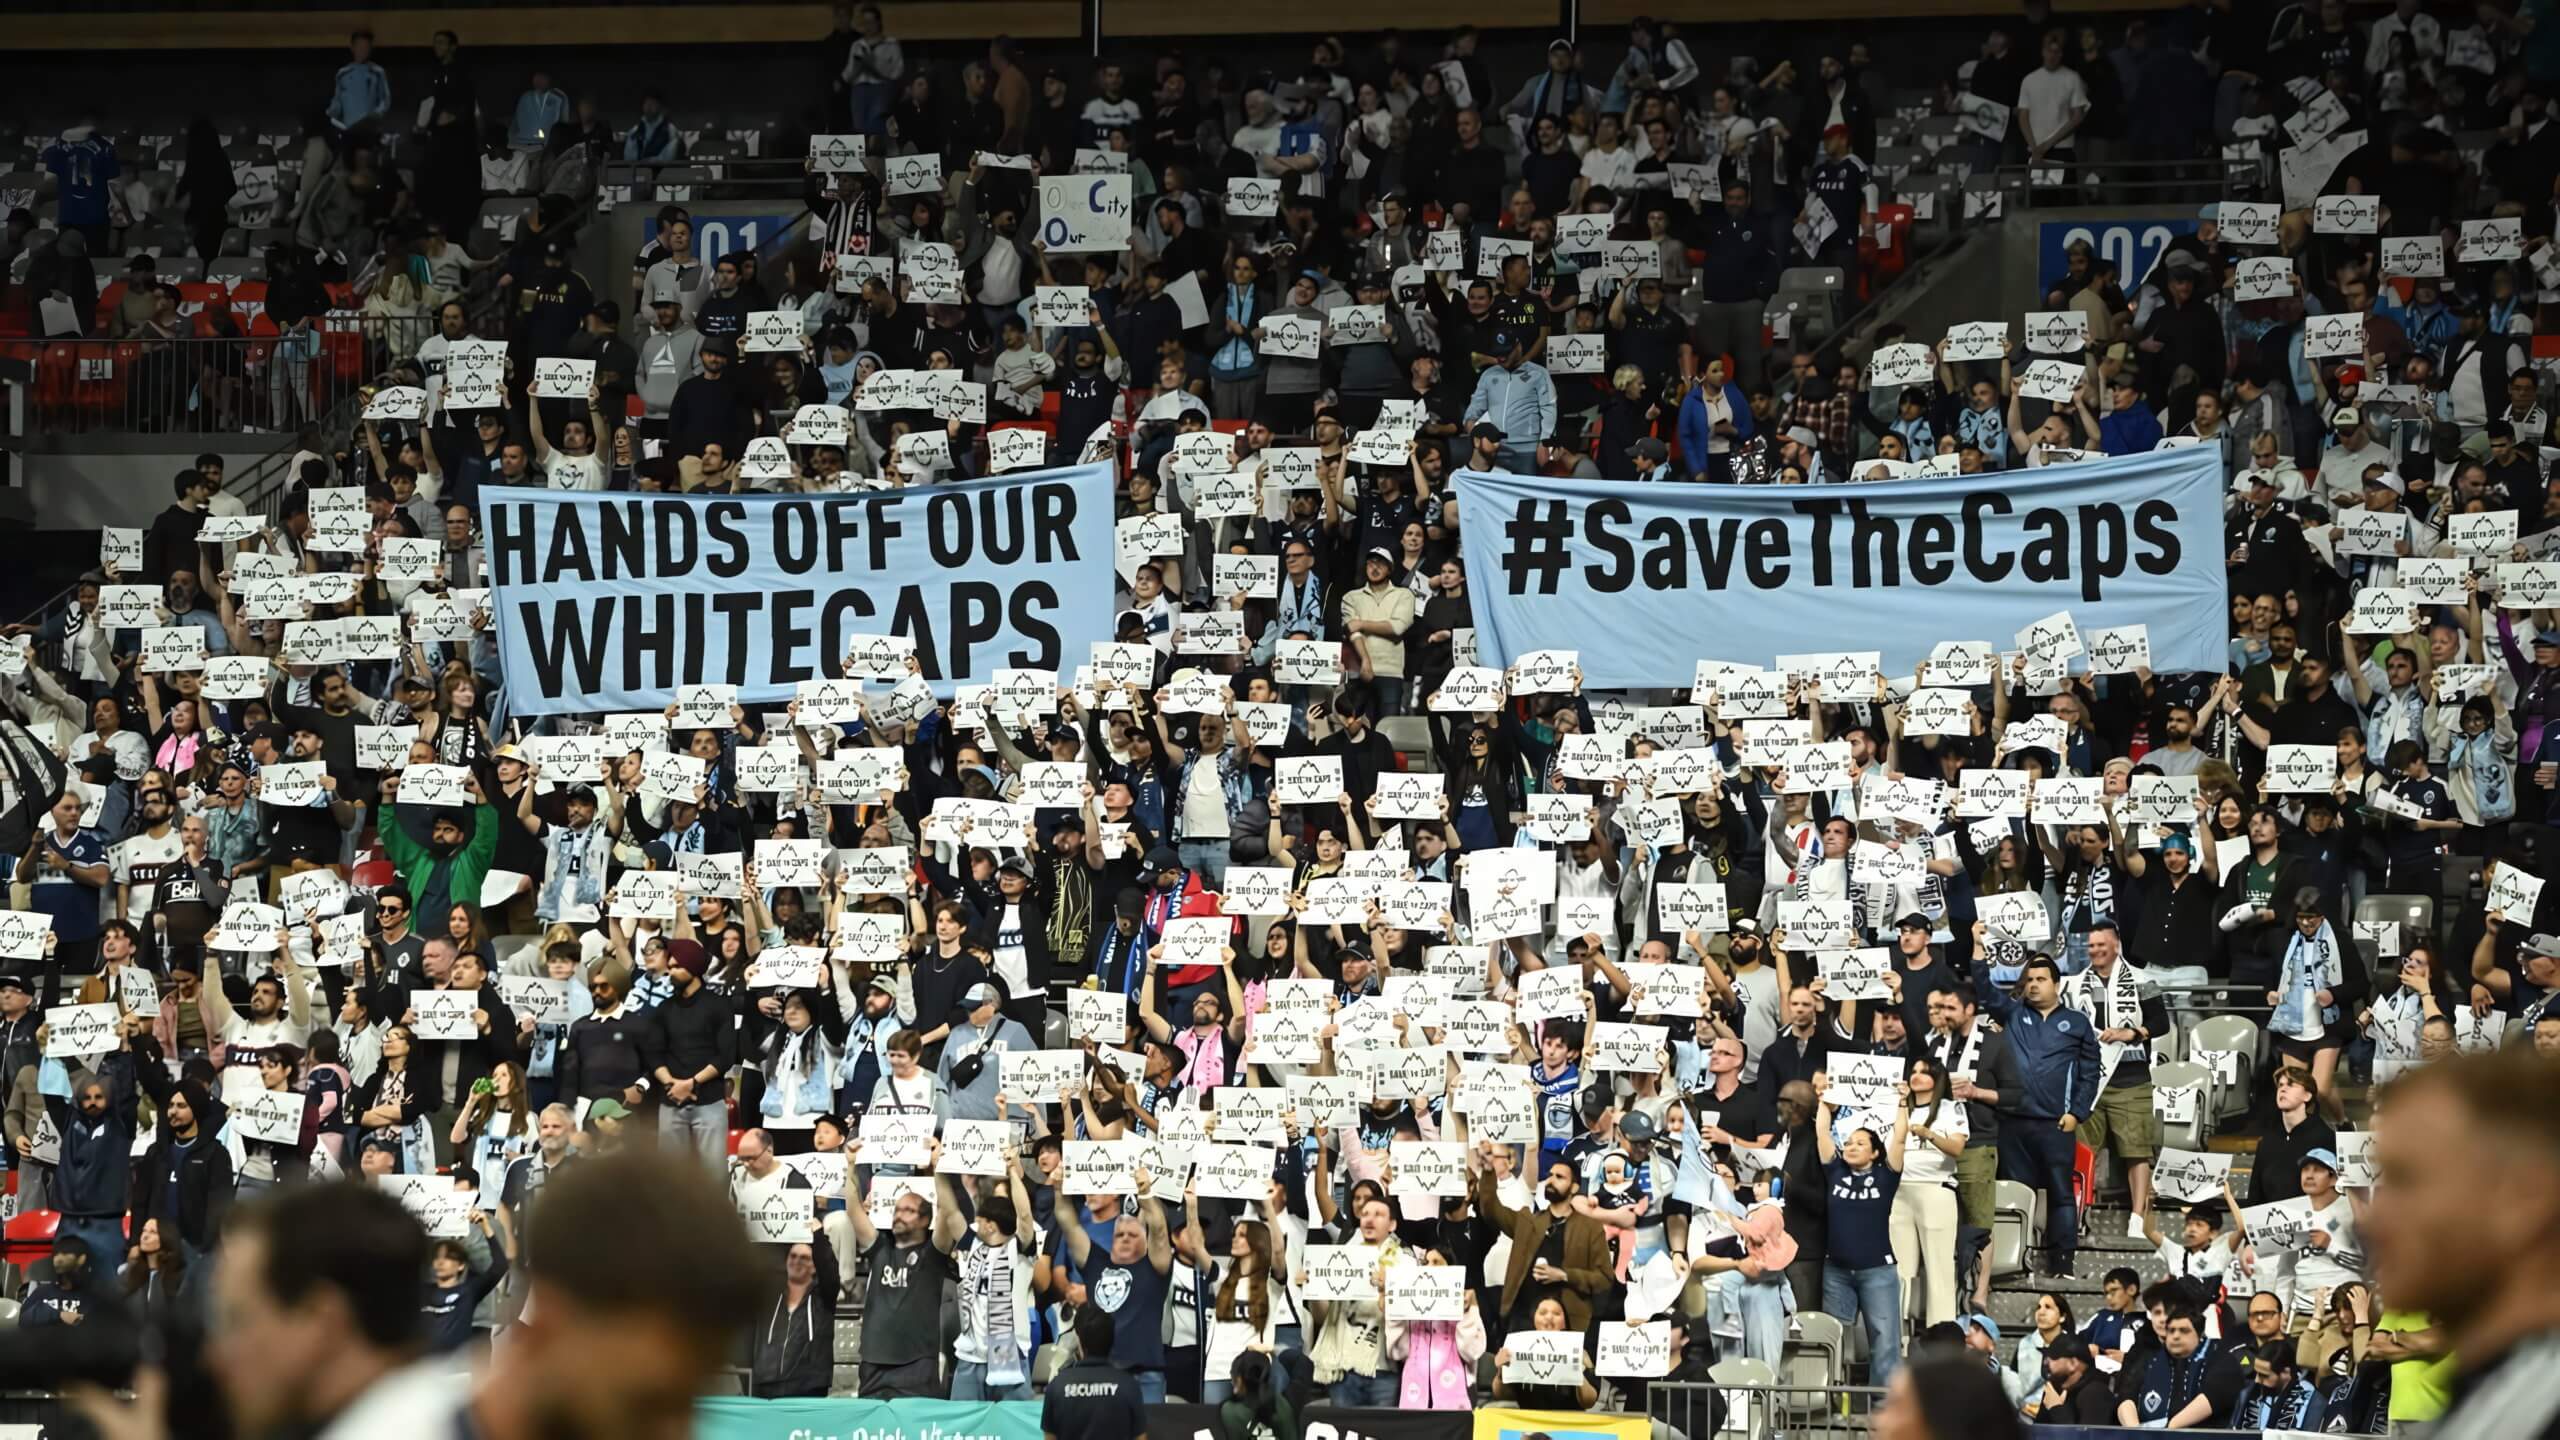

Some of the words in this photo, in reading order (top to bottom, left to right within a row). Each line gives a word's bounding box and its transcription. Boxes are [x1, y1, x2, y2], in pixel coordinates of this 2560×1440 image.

[1089, 179, 1128, 218] City
[1045, 217, 1087, 247] Our
[490, 500, 749, 586] HANDS
[773, 496, 904, 575] OFF
[927, 483, 1080, 568] OUR
[1501, 492, 2182, 602] #SaveTheCaps
[519, 580, 1061, 699] WHITECAPS
[132, 868, 160, 880] TEL
[234, 1051, 257, 1062] TEL
[1064, 1383, 1119, 1399] SECURITY
